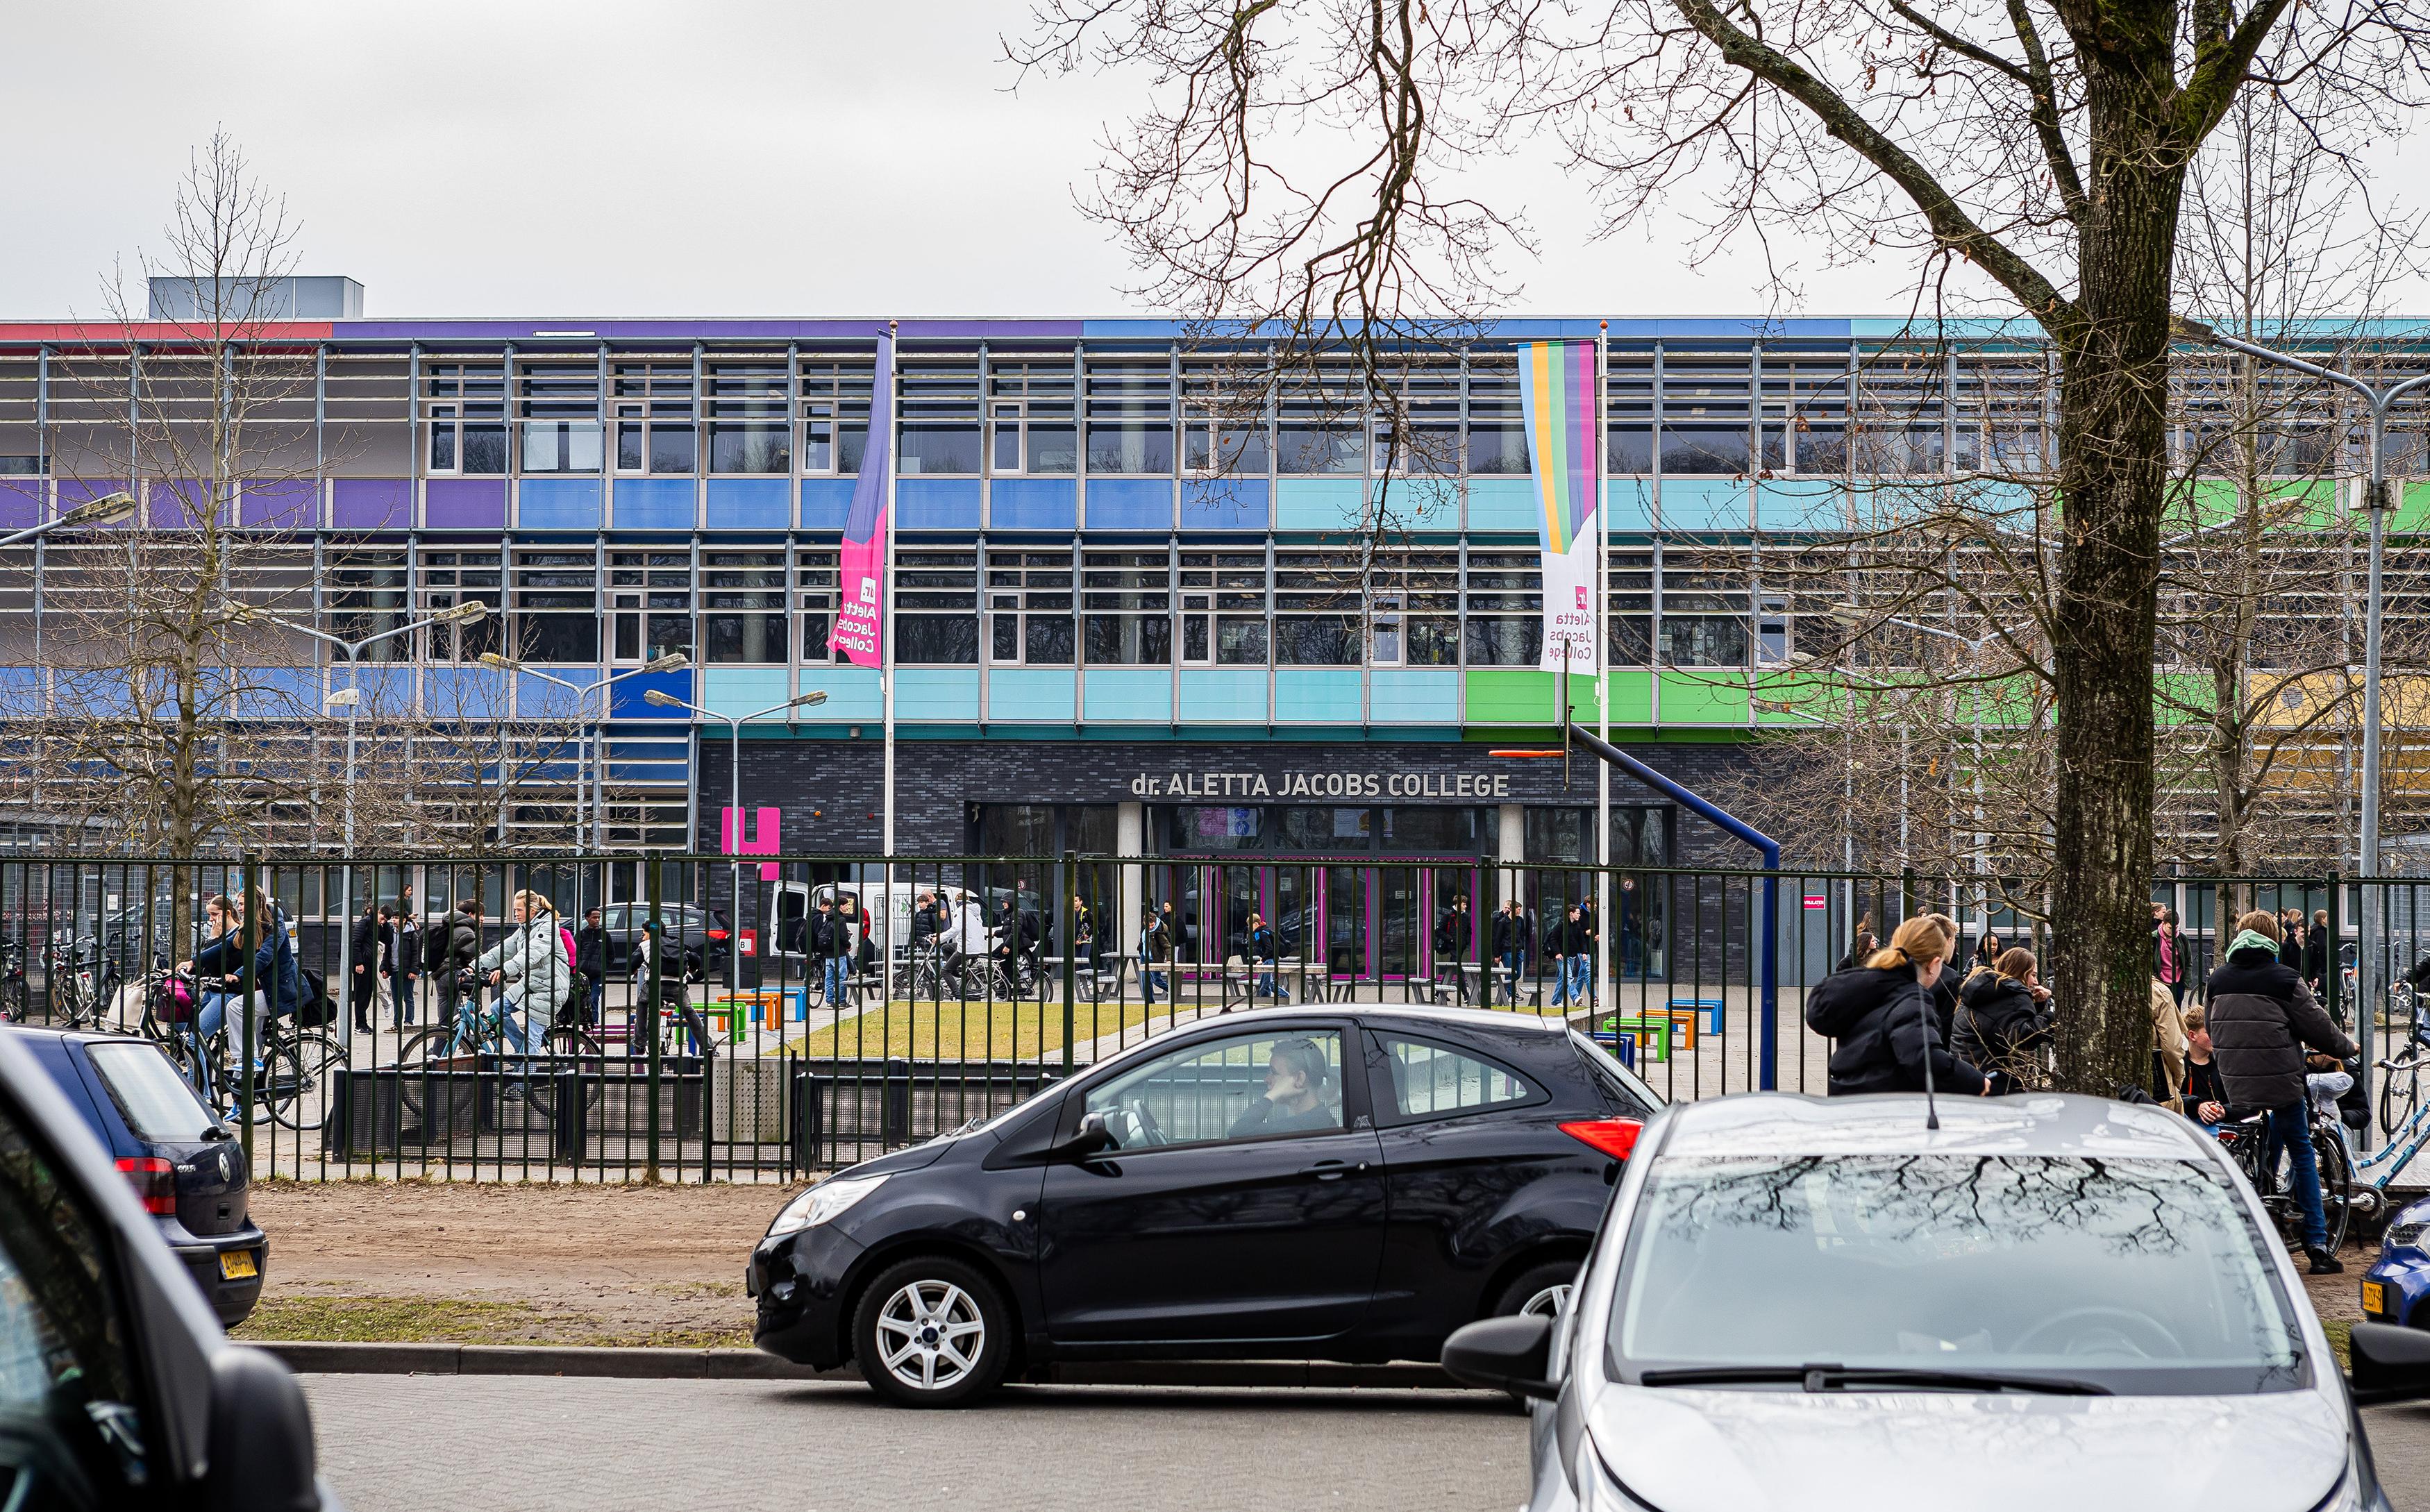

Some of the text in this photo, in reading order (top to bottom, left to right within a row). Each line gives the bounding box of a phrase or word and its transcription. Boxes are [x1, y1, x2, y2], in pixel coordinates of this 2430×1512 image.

[1132, 773, 1509, 797] dr. ALETTA JACOBS COLLEGE
